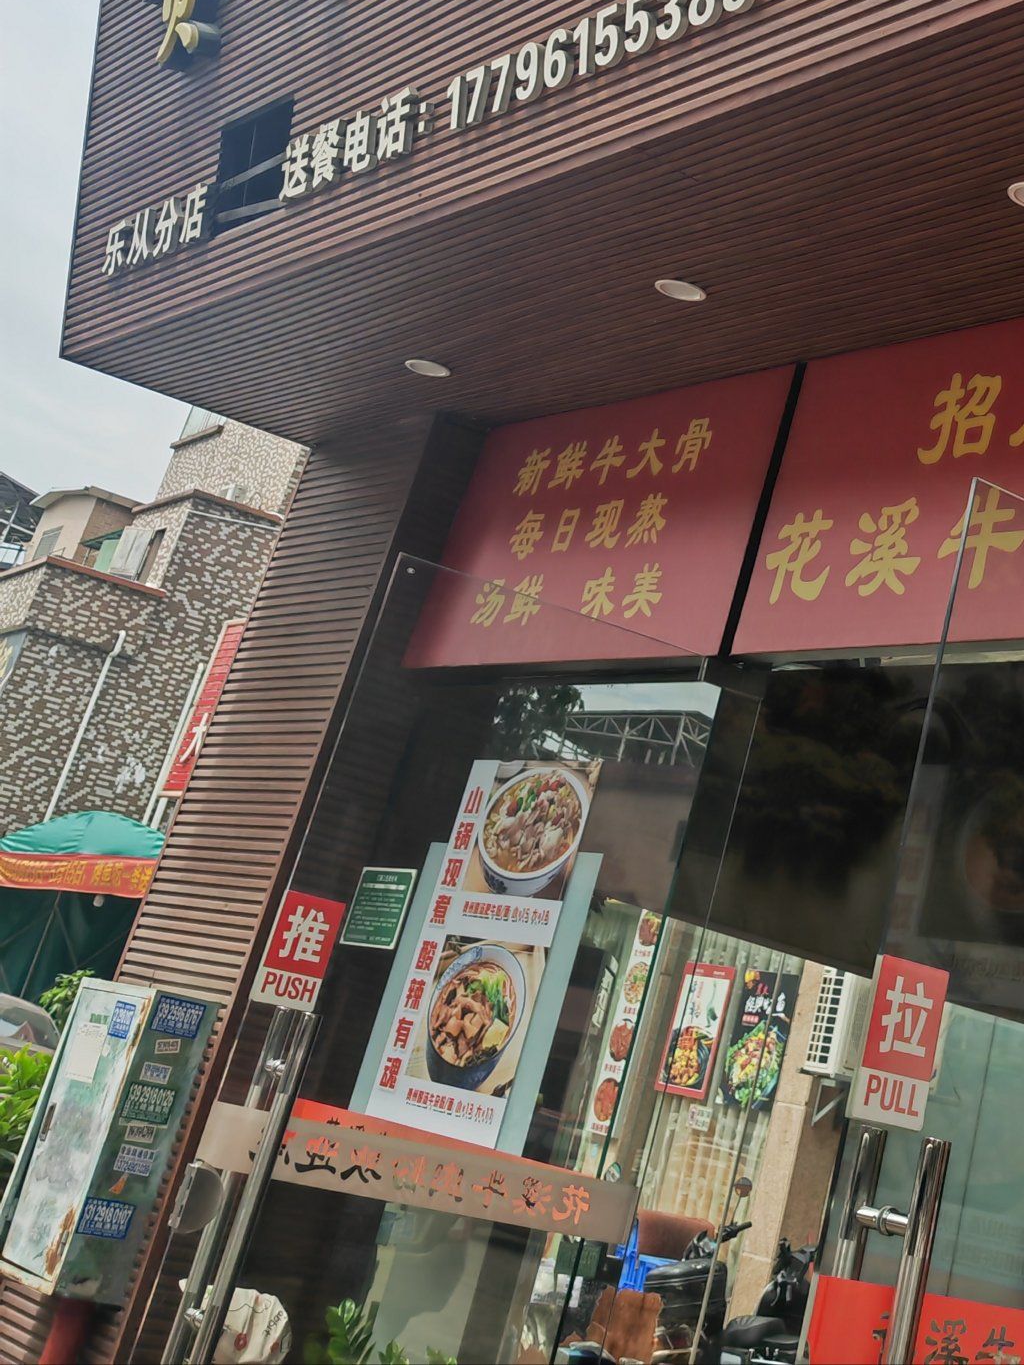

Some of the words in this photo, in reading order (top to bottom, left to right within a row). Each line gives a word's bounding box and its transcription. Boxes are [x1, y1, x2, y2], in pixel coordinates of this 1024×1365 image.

[100, 183, 208, 276] 乐从分店
[513, 417, 713, 494] 新鲜牛大骨
[508, 493, 669, 560] 每日现熬
[469, 579, 541, 628] 汤鲜
[579, 563, 664, 622] 味美
[430, 786, 484, 924] 小锅现煮
[279, 905, 330, 963] 推
[260, 971, 317, 1003] PUSH
[379, 940, 438, 1090] 酸辣有魂
[879, 975, 934, 1058] 拉
[863, 1073, 919, 1117] PULL
